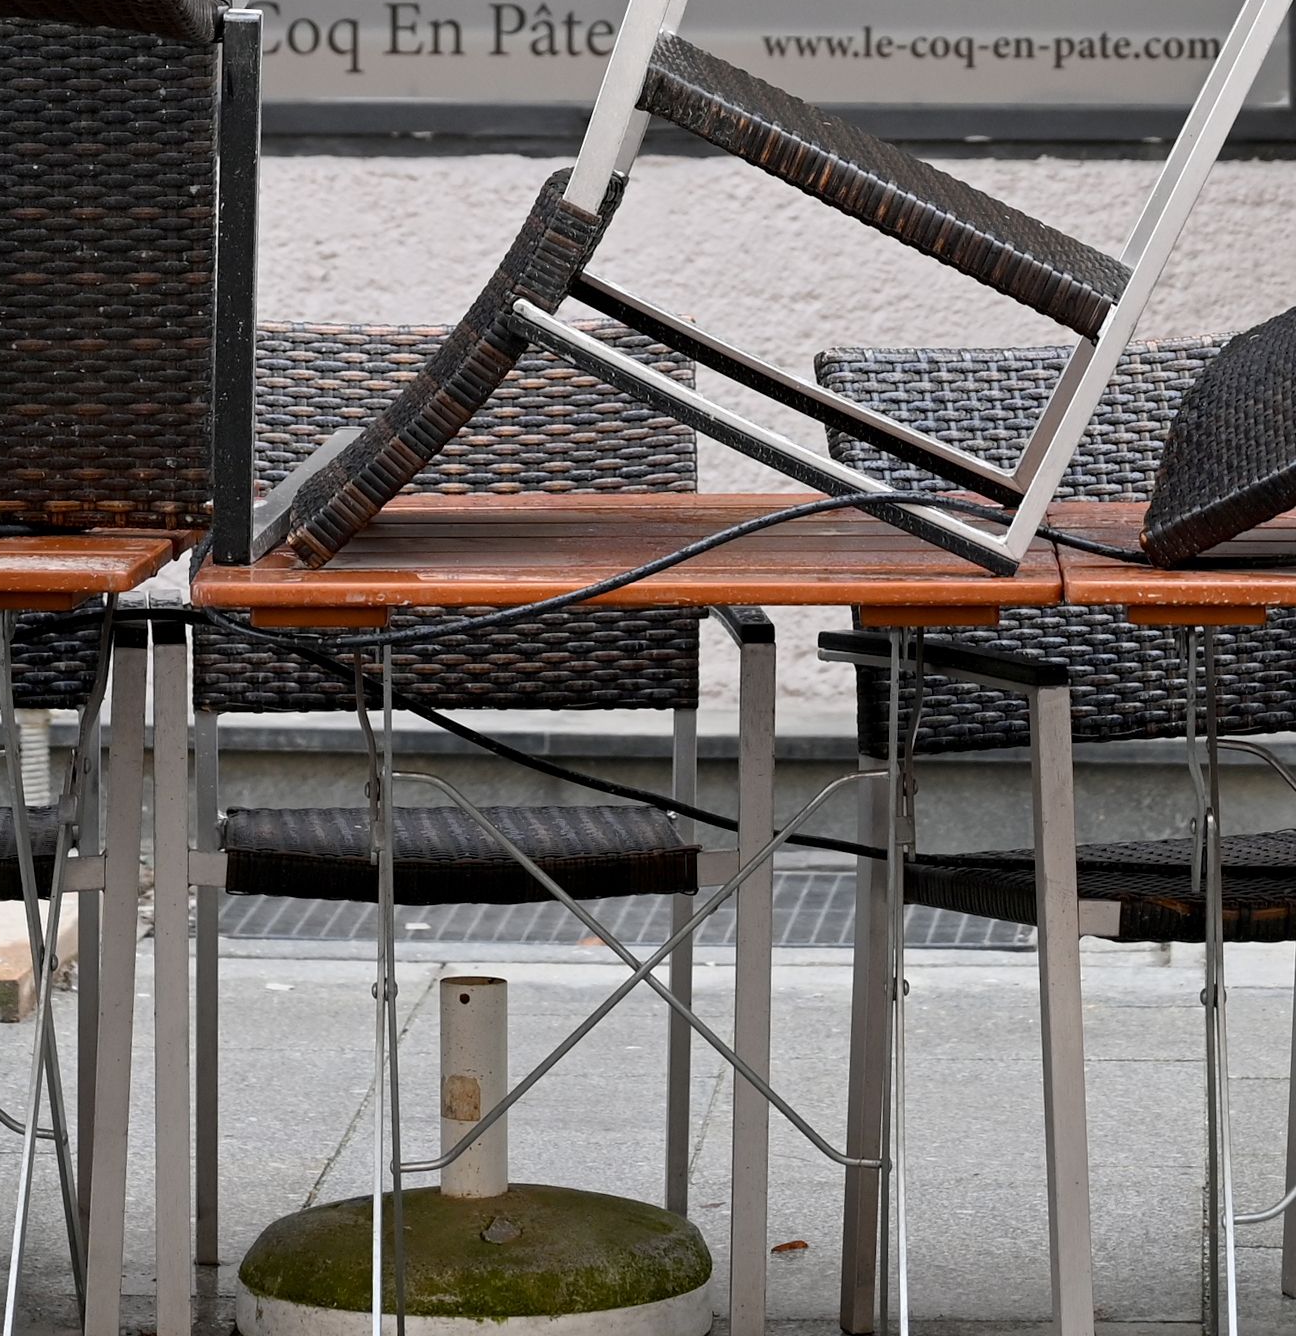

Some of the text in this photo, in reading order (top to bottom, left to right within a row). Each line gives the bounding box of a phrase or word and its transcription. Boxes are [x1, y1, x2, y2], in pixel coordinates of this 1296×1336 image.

[383, 2, 464, 56] En
[488, 1, 615, 56] Pâte
[762, 26, 1221, 68] www.le-coq-en-pate.com
